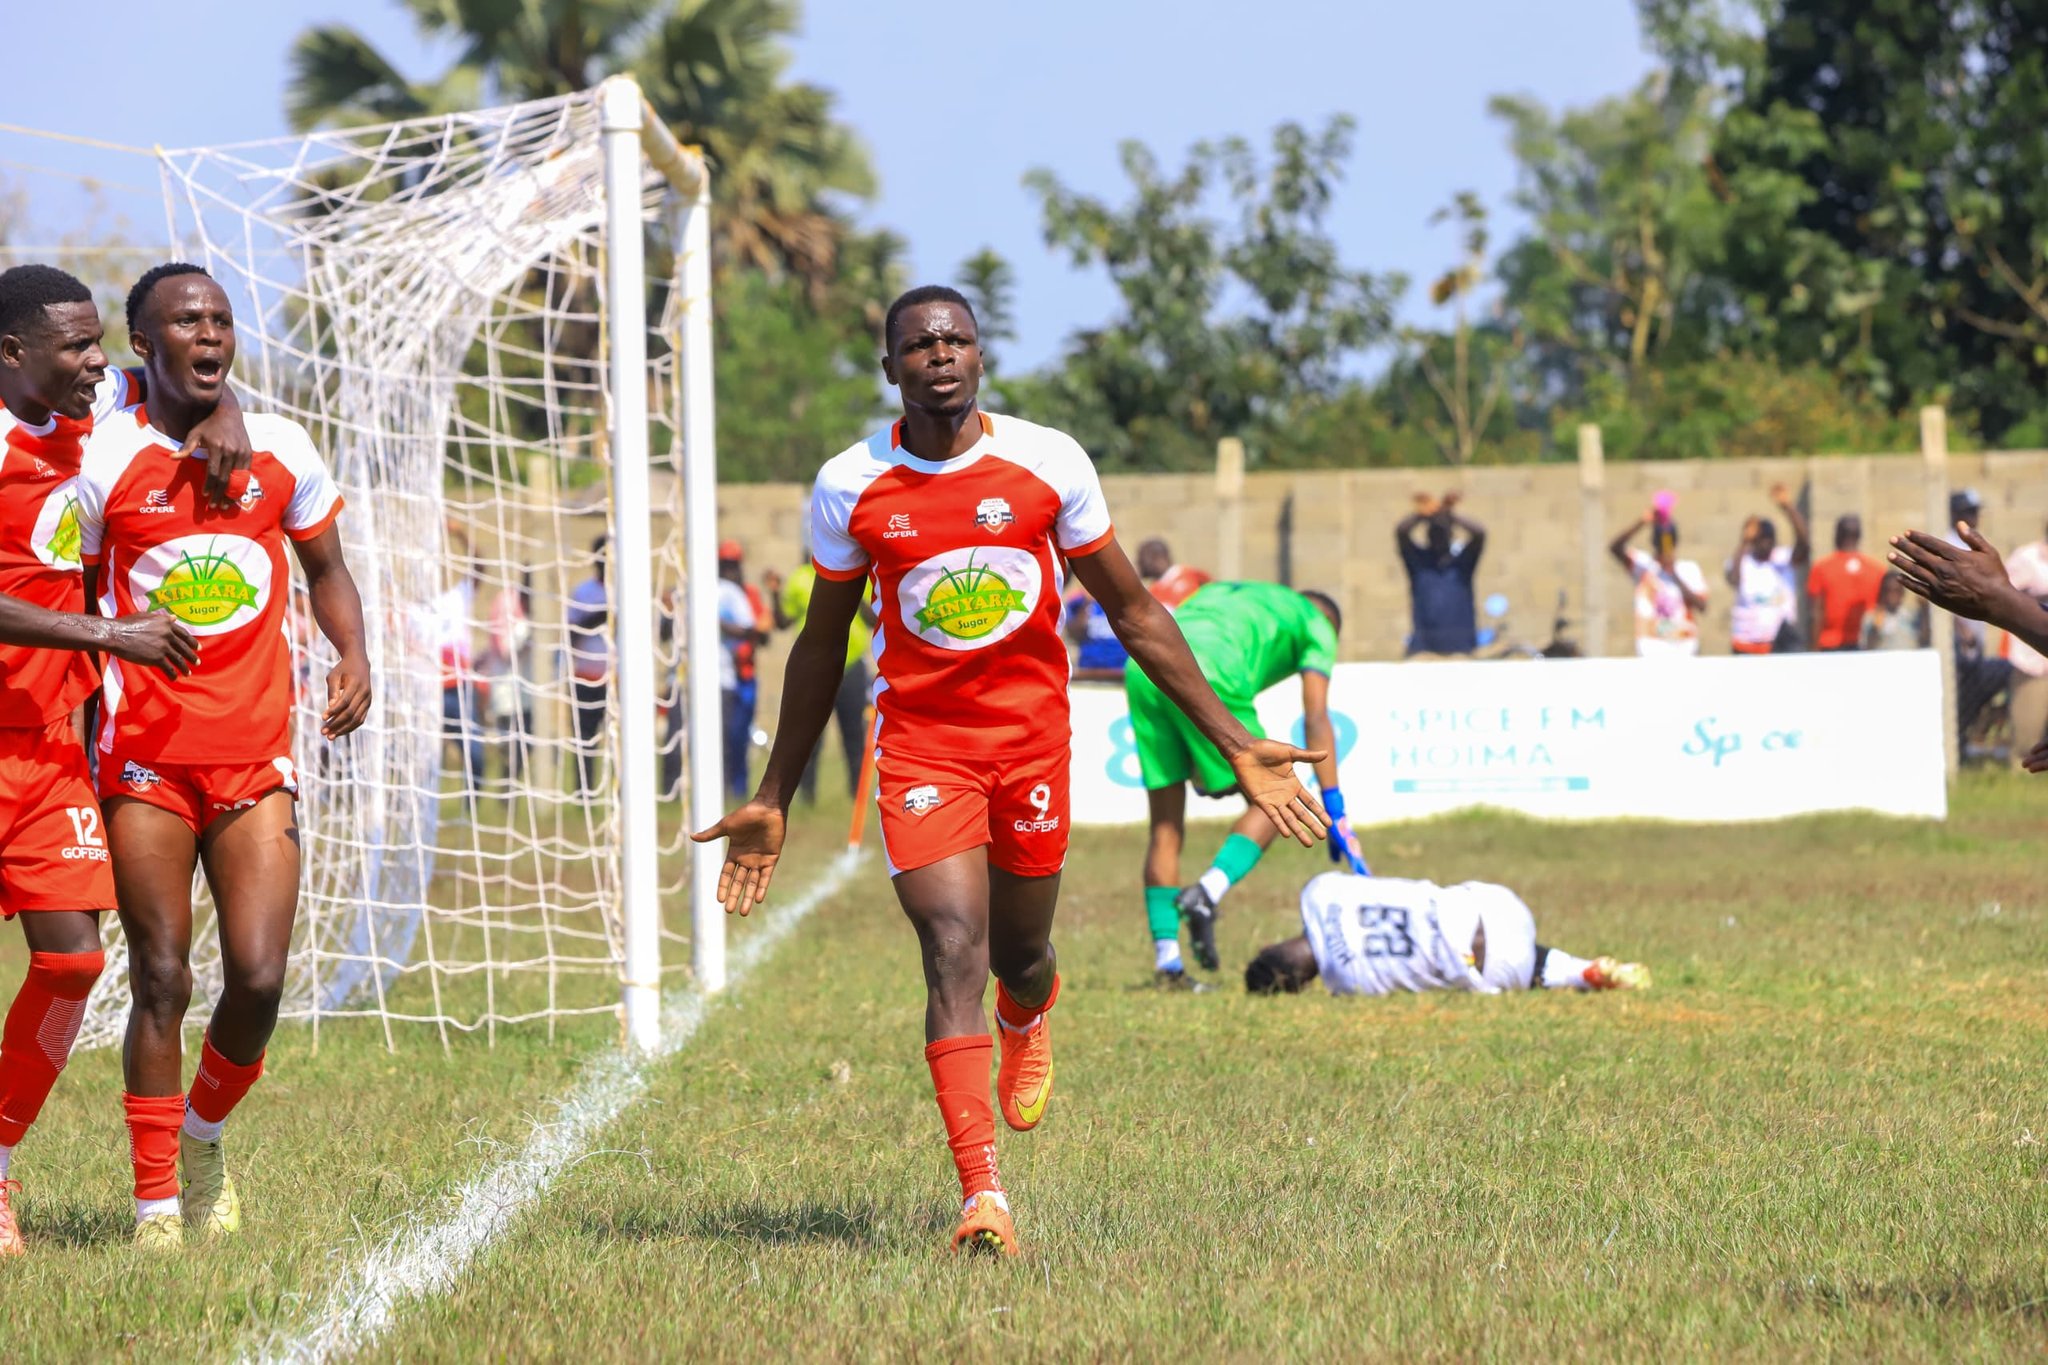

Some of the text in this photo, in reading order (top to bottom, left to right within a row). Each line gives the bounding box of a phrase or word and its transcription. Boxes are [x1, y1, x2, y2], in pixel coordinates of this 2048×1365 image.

[139, 505, 175, 514] GOFERE
[883, 530, 918, 539] GOFERE
[155, 582, 250, 606] KINYARA
[189, 603, 221, 616] Sugar
[923, 592, 1016, 623] KINYARA
[957, 616, 989, 630] Sugar
[1389, 706, 1605, 732] SPICE FM
[1681, 715, 1804, 767] Spce
[1390, 743, 1554, 768] HOIMA
[1029, 783, 1051, 820] 9
[65, 807, 103, 846] 12
[1014, 816, 1059, 833] GOFERE
[61, 847, 108, 862] GOFERE
[1358, 905, 1414, 958] 23
